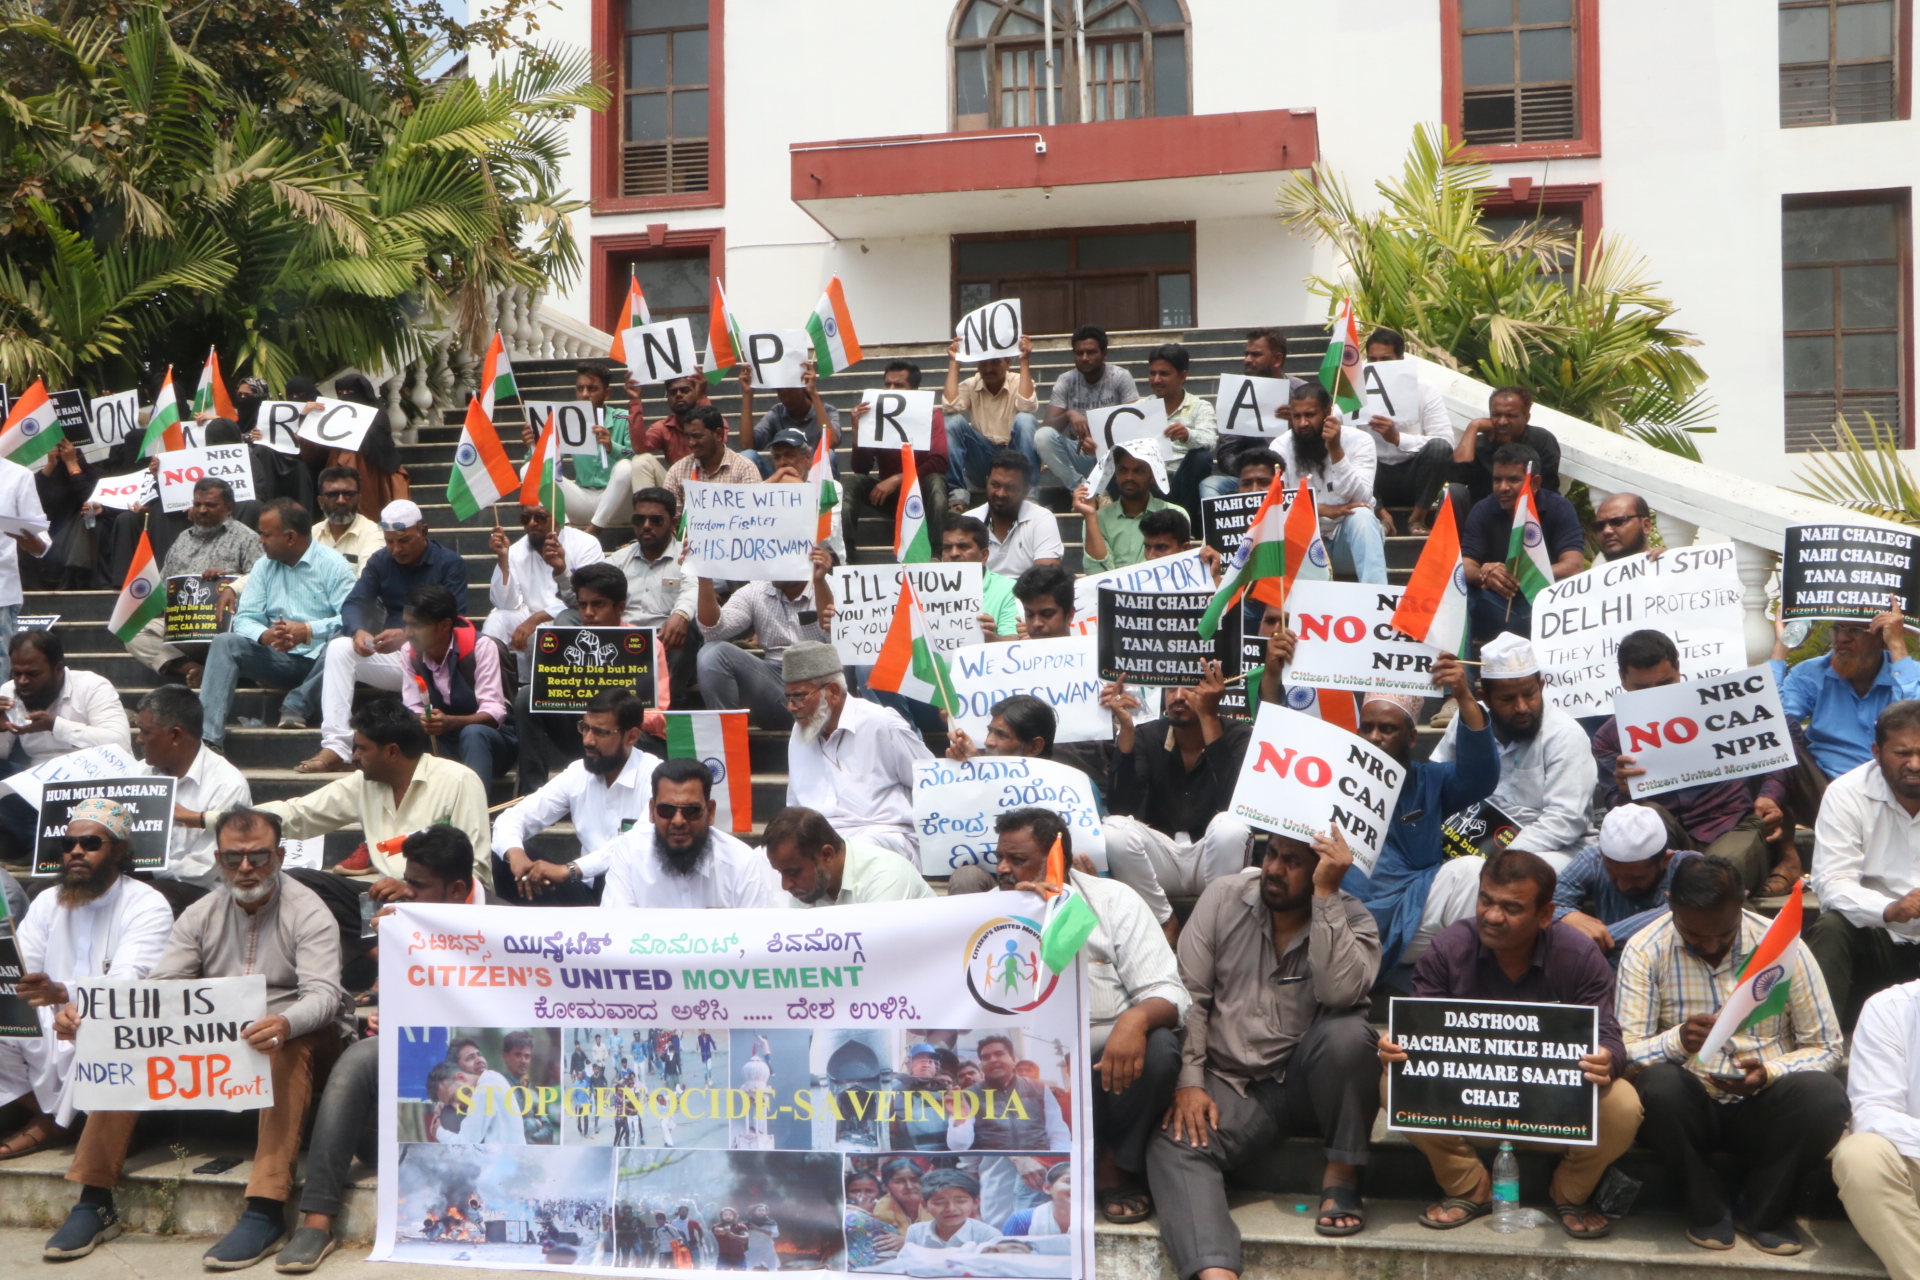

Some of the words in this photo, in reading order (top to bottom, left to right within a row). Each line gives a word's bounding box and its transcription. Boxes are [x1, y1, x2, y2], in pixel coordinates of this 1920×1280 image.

[963, 302, 1019, 356] NO
[642, 327, 683, 380] N
[749, 333, 784, 384] P
[1351, 364, 1396, 420] A
[1226, 379, 1264, 432] A
[269, 403, 300, 448] R
[317, 404, 358, 442] C
[529, 404, 587, 447] NO
[874, 393, 908, 443] R
[205, 448, 243, 461] NRC
[163, 466, 205, 486] NO
[208, 464, 246, 476] CAA
[99, 484, 138, 497] NO
[690, 489, 707, 509] WE
[713, 489, 745, 509] ARE
[753, 490, 801, 508] WITH
[1214, 497, 1243, 512] NAHI
[729, 515, 778, 531] Fighter
[1215, 515, 1245, 530] NAHI
[1800, 527, 1840, 542] NAHI
[1842, 528, 1912, 549] CHALEGI
[1798, 548, 1838, 563] NAHI
[1840, 549, 1911, 570] CHALEGI
[1547, 573, 1592, 604] YOU
[1603, 553, 1665, 588] CAN'T
[1671, 547, 1734, 574] STOP
[1804, 569, 1847, 584] TANA
[1850, 570, 1902, 588] SHAHI
[842, 570, 887, 605] I'LL
[894, 570, 962, 596] SHOW
[1796, 590, 1835, 605] NAHI
[1115, 594, 1153, 610] NAHI
[1156, 593, 1214, 611] CHALEG
[1784, 606, 1818, 616] Citizen
[1820, 605, 1860, 616] United
[192, 613, 216, 621] Accep
[834, 609, 864, 622] YOU
[872, 606, 888, 618] MY
[1115, 615, 1153, 631] NAHI
[1540, 593, 1633, 640] DELHI
[201, 622, 217, 630] NPR
[837, 626, 850, 640] IF
[859, 622, 888, 635] YOU
[950, 617, 974, 630] ME
[1297, 613, 1367, 644] NO
[1122, 636, 1164, 653] TANA
[1167, 638, 1216, 654] SHAHI
[1545, 644, 1595, 667] THEY
[538, 664, 571, 675] Ready
[572, 664, 584, 674] to
[586, 664, 604, 674] Die
[607, 664, 626, 674] but
[628, 665, 648, 674] Not
[1114, 657, 1153, 673] NAHI
[1372, 652, 1433, 673] NPR
[547, 677, 582, 688] Ready
[584, 677, 596, 686] to
[598, 677, 637, 688] Accept
[1141, 671, 1178, 682] United
[1290, 670, 1330, 683] Citizen
[1333, 673, 1372, 686] United
[1544, 664, 1606, 689] RIGHTS
[547, 689, 575, 699] NRC,
[1696, 675, 1765, 706] NRC
[534, 700, 566, 709] Citizen
[568, 700, 588, 709] Unit
[1704, 704, 1774, 732] CAA
[1625, 716, 1699, 753] NO
[1712, 731, 1781, 760] NPR
[1252, 741, 1333, 788] NO
[1347, 744, 1398, 789] NRC
[1636, 777, 1679, 793] Citizen
[1681, 766, 1722, 783] United
[1724, 752, 1790, 775] Movement
[46, 788, 71, 802] HUM
[72, 786, 105, 800] MULK
[106, 784, 168, 798] BACHANE
[1339, 776, 1386, 821] CAA
[131, 819, 164, 832] AATH
[1235, 804, 1279, 826] Citizen
[1329, 804, 1379, 851] NPR
[38, 861, 61, 872] Citiz
[993, 923, 1021, 933] UNITED
[407, 964, 553, 988] CITIZEN'S
[558, 967, 673, 991] UNITED
[681, 965, 864, 991] MOVEMENT
[77, 986, 160, 1020] DELHI
[183, 986, 216, 1016] IS
[786, 997, 835, 1020] ದೇಶ
[1444, 1011, 1540, 1032] DASTHOOR
[1397, 1034, 1481, 1054] BACHANE
[1484, 1038, 1538, 1058] NIKLE
[1541, 1042, 1588, 1060] HAIN
[146, 1053, 232, 1101] BJP
[1402, 1059, 1440, 1077] AAO
[1442, 1062, 1518, 1083] HAMARE
[1521, 1068, 1582, 1086] SAATH
[1461, 1088, 1520, 1109] CHALE
[1396, 1110, 1447, 1126] Citizen
[1452, 1114, 1502, 1130] United
[1506, 1118, 1588, 1137] Movement
